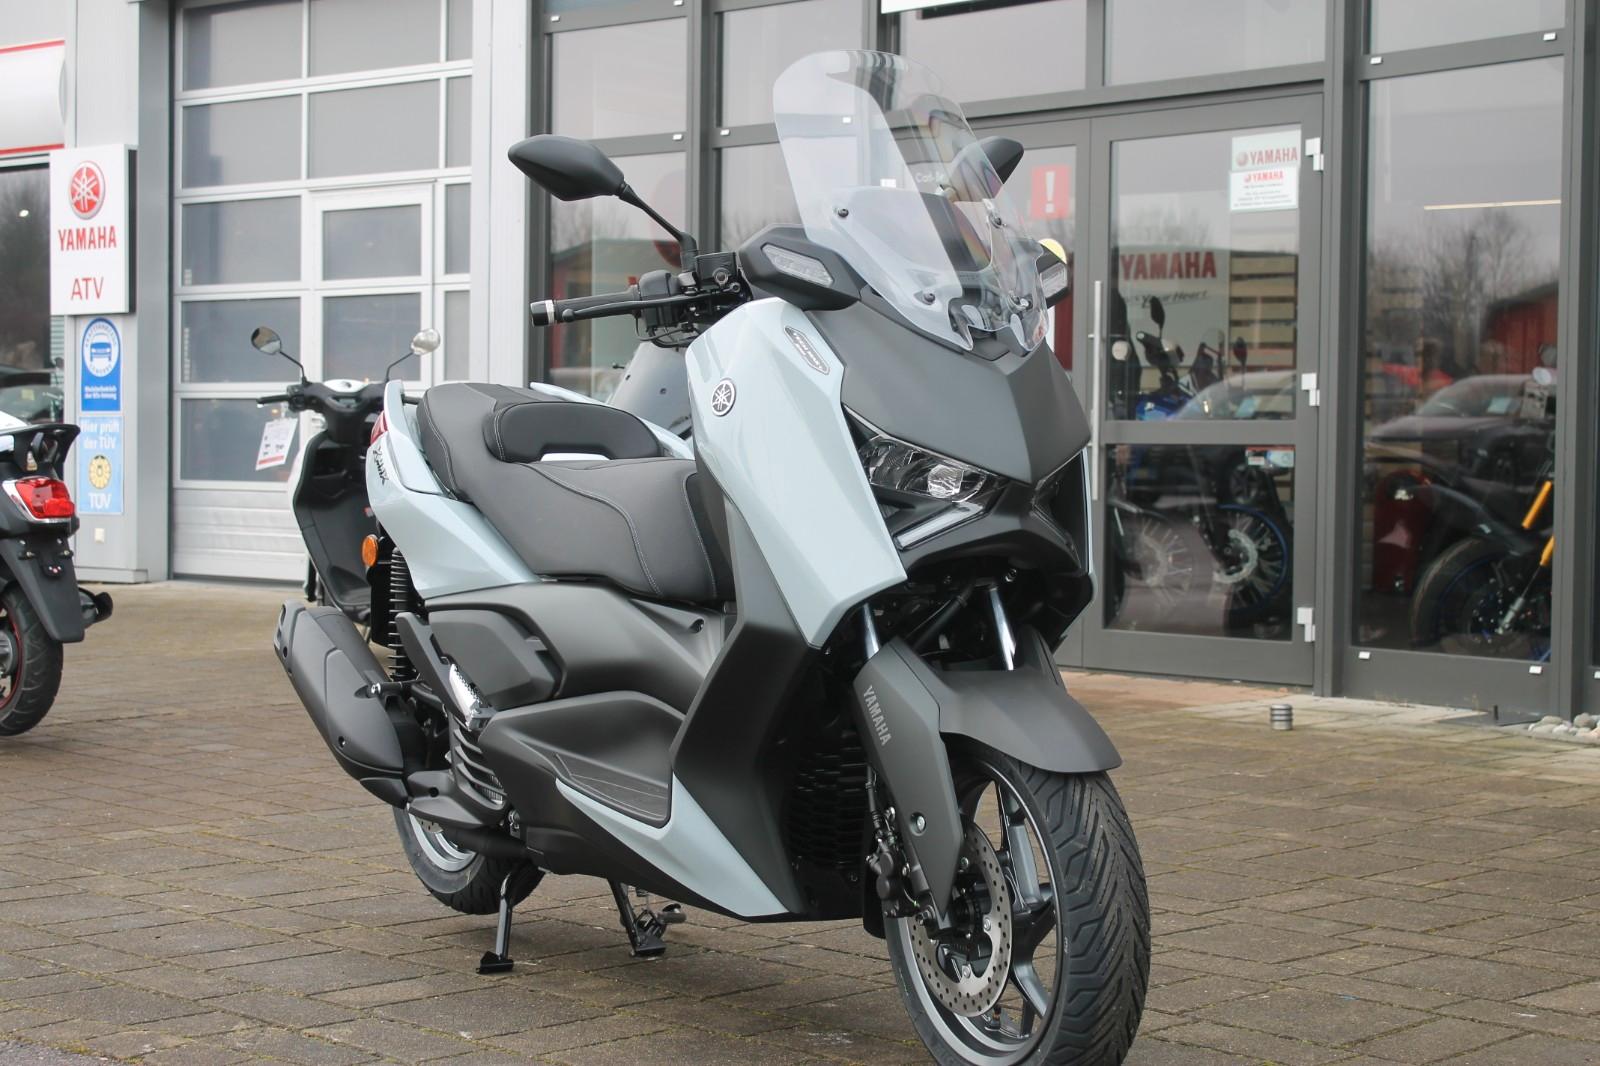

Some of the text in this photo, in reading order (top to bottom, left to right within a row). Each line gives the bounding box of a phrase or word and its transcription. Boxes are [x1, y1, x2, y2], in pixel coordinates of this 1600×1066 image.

[1250, 147, 1298, 165] YAMAHA
[58, 225, 117, 251] YAMAHA
[1120, 251, 1217, 280] YAMAHA
[70, 276, 104, 301] ATV
[81, 419, 120, 435] Hier prüft
[84, 434, 117, 449] der TÜV
[863, 684, 892, 747] YAMAHA
